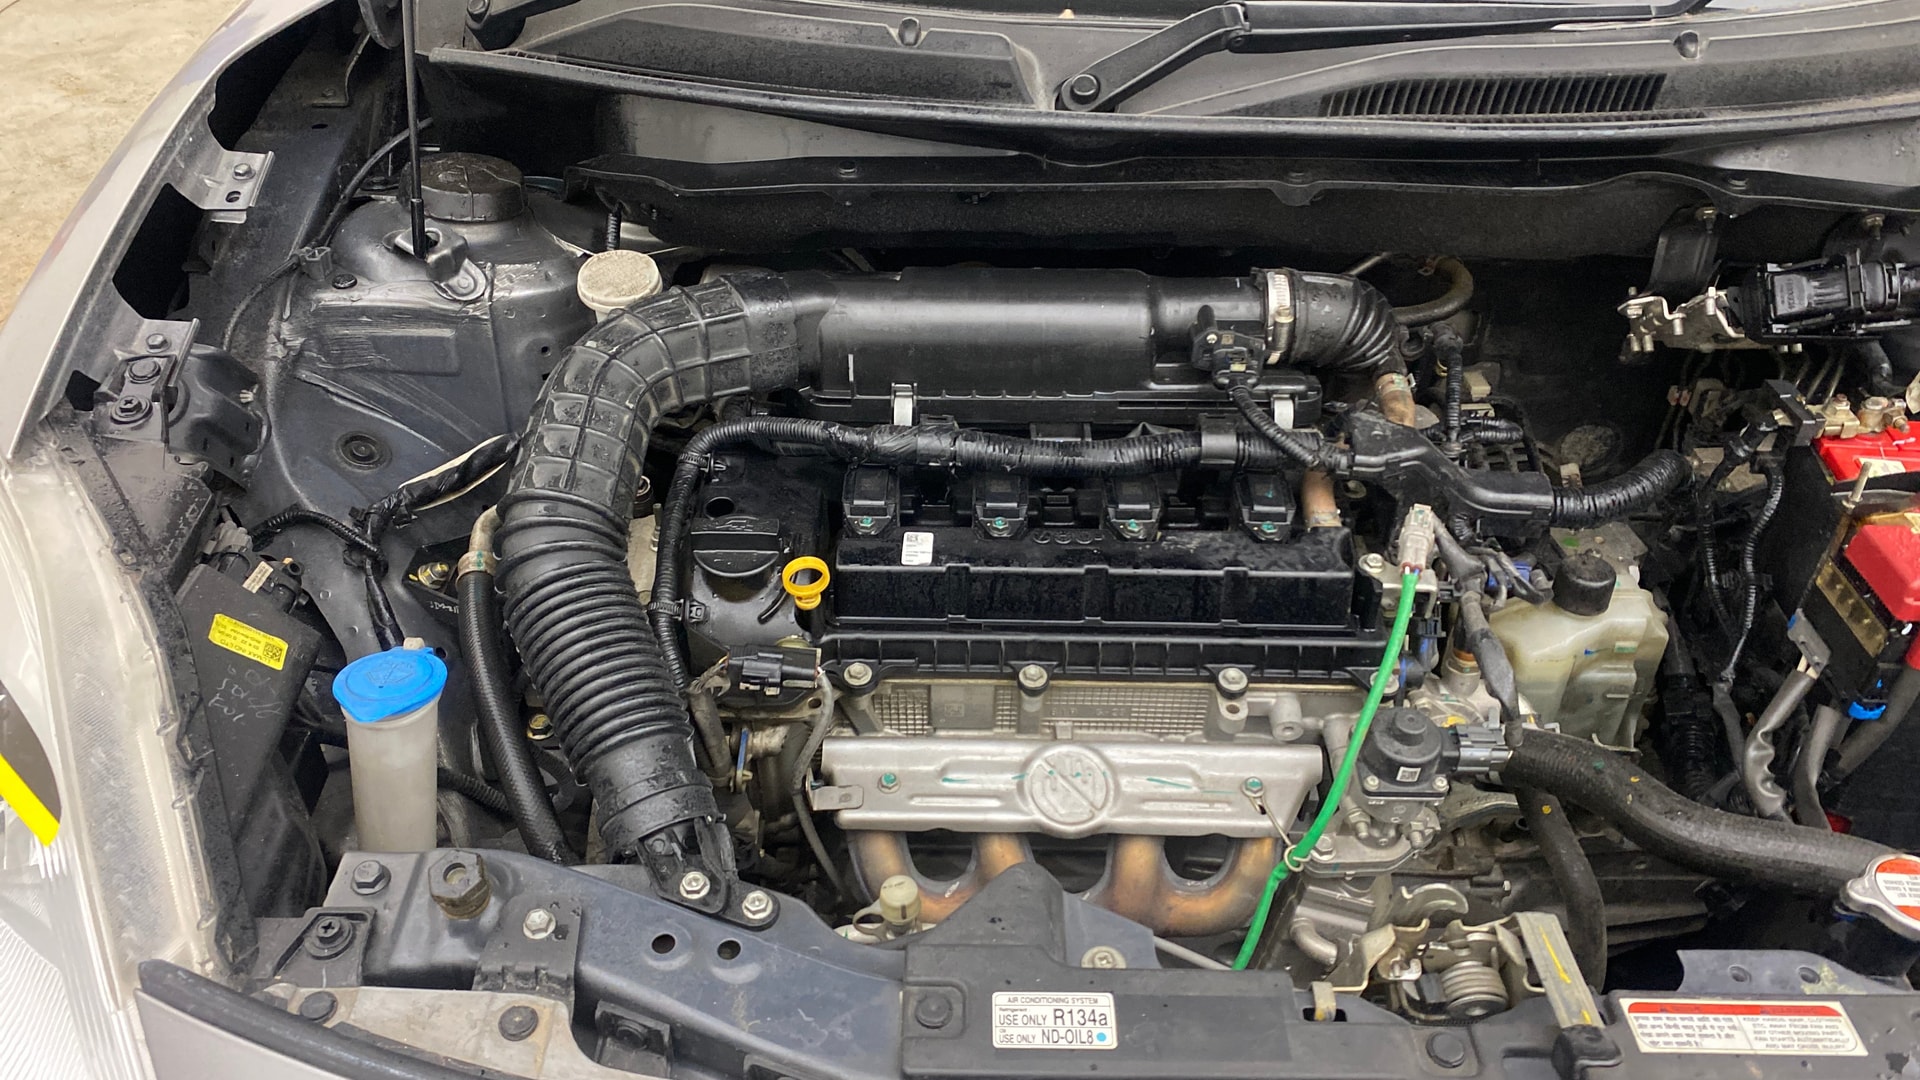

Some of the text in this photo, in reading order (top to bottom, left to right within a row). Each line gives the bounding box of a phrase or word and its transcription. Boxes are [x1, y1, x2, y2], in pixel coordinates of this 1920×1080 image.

[1007, 996, 1019, 1004] AIR
[1020, 996, 1070, 1004] CONDITIONING
[999, 1008, 1108, 1026] USE ONLY R134a
[999, 1028, 1094, 1045] USE ONLY ND-OIL8
